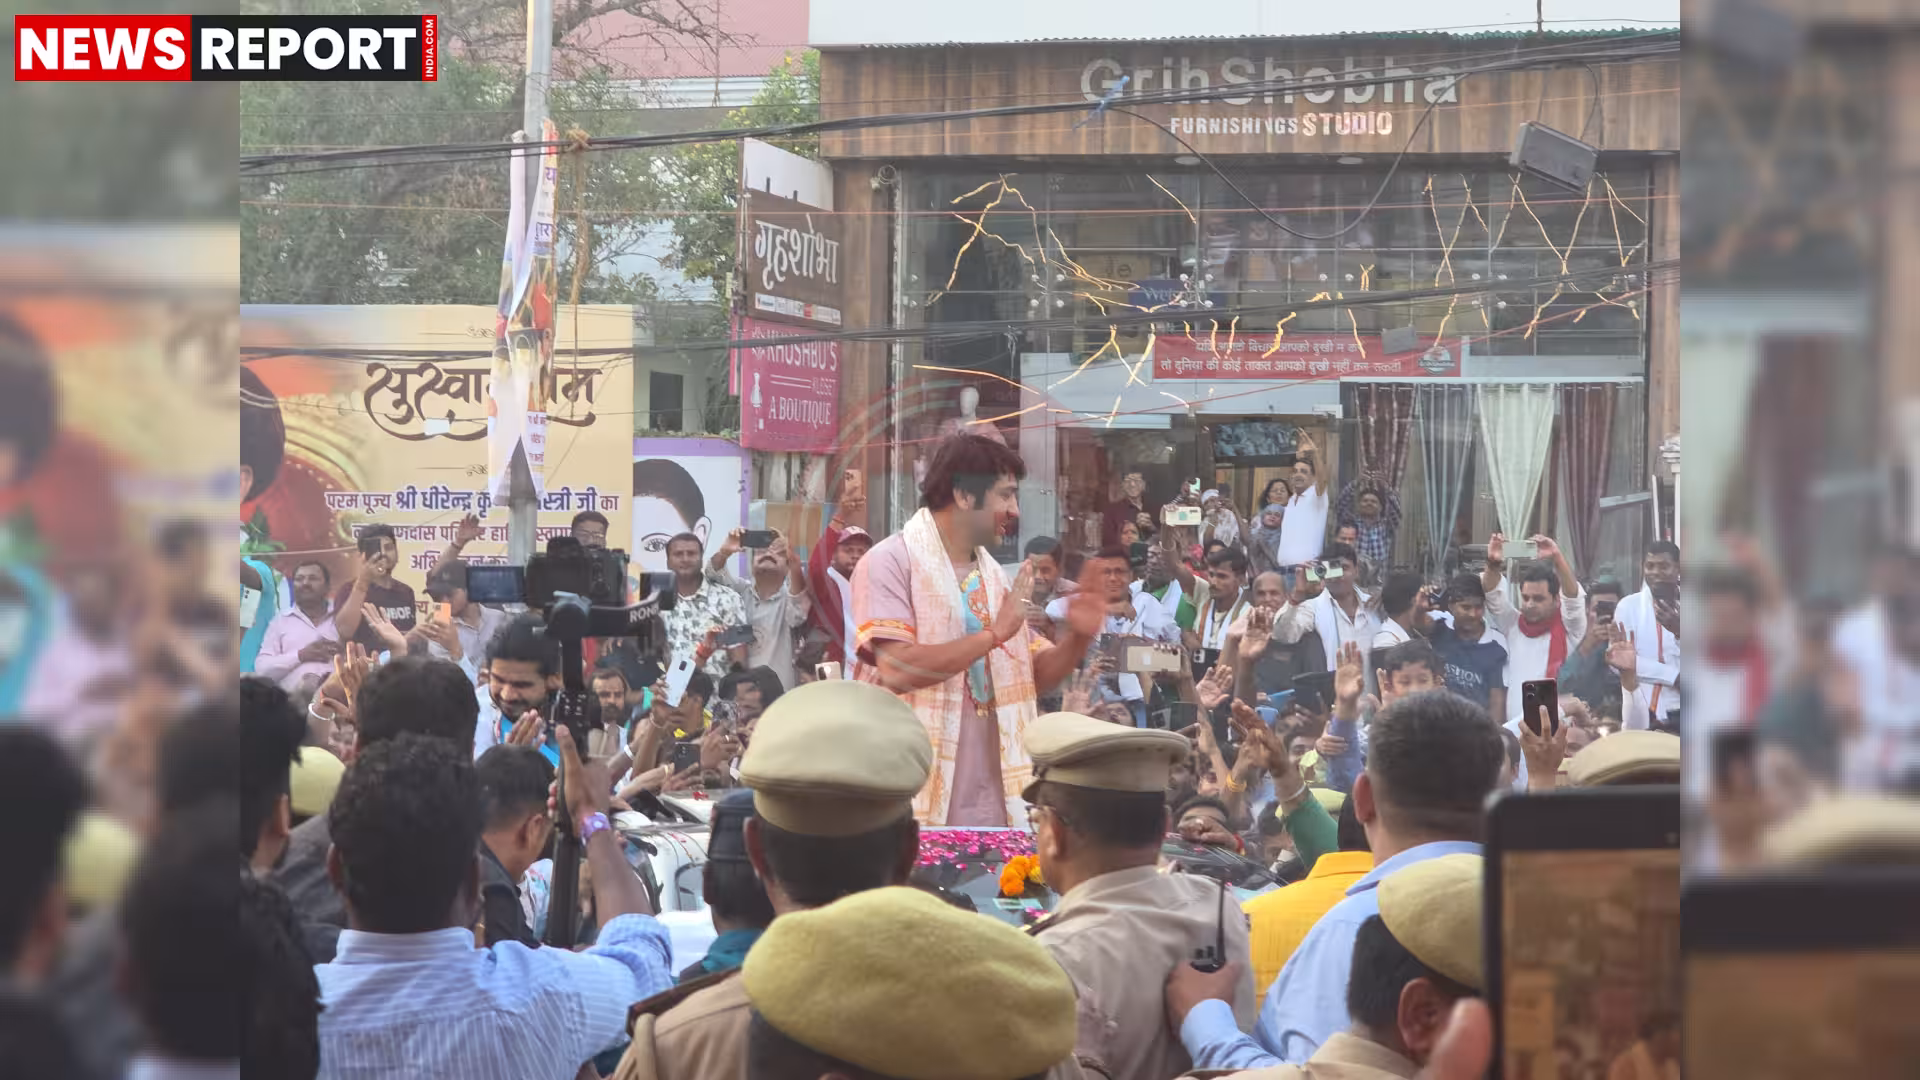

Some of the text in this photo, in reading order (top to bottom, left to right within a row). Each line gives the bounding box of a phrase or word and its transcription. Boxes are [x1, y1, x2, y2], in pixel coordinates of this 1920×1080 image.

[1302, 111, 1393, 137] STUDIO
[755, 212, 839, 290] गृहशोभा
[768, 396, 832, 430] A BOUTIQUE
[327, 493, 359, 509] परम
[362, 493, 391, 514] पूज्य
[396, 485, 418, 510] श्री
[420, 485, 473, 511] धीरेन्द्र
[574, 486, 598, 511] जी
[600, 495, 619, 511] का
